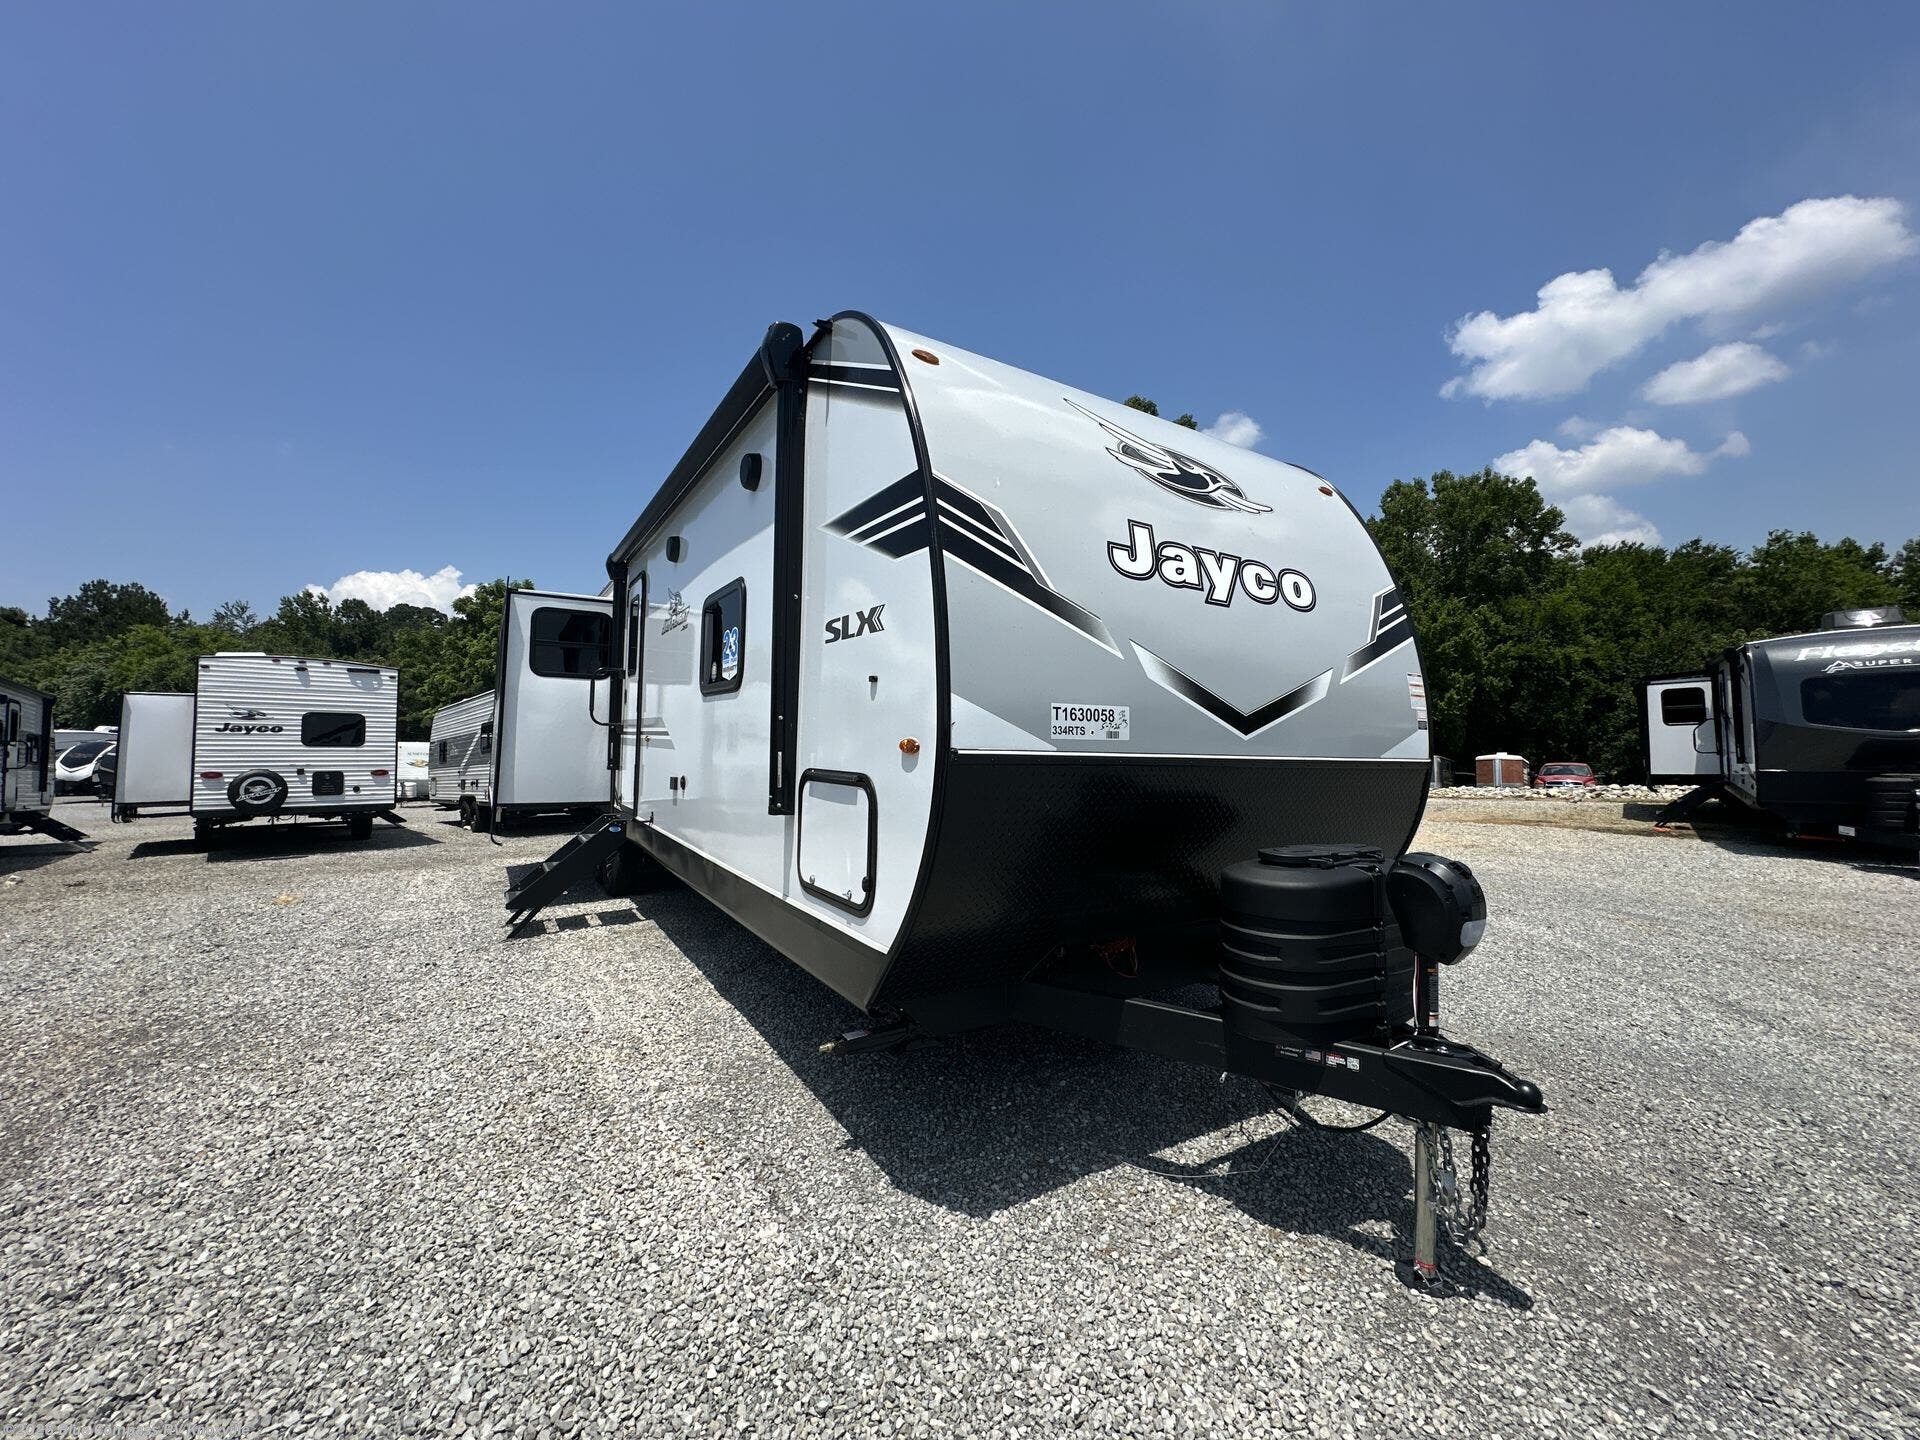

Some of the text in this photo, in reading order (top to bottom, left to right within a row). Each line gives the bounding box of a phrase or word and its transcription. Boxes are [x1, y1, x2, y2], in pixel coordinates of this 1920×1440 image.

[1107, 518, 1317, 613] Jayco
[825, 604, 886, 644] SLX
[1854, 658, 1913, 667] SUPER
[1052, 706, 1115, 722] T1630058
[215, 722, 284, 735] Jayco
[1052, 725, 1086, 735] 334RTS
